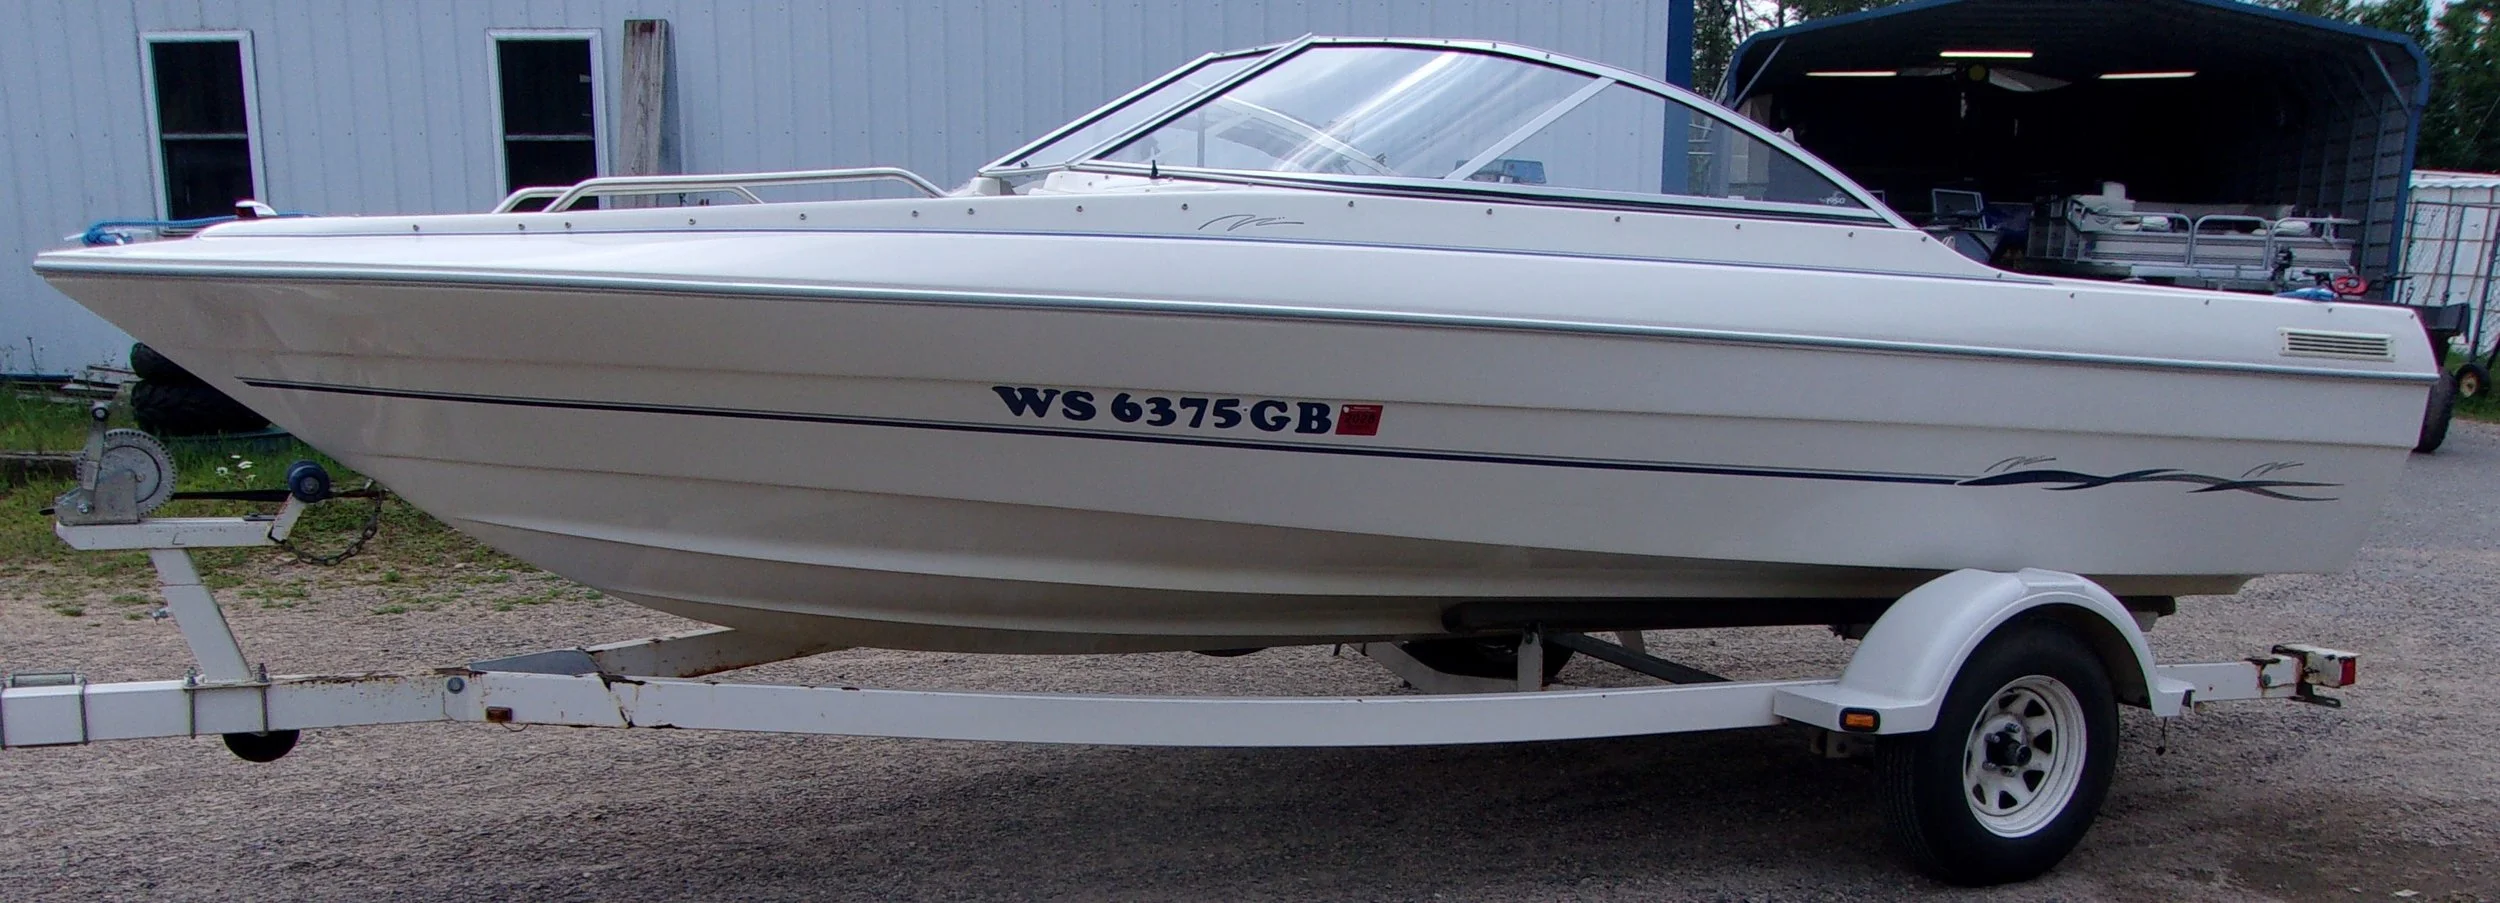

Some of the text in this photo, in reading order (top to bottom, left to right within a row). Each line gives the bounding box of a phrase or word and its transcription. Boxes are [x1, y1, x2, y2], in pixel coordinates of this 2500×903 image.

[991, 385, 1333, 435] WS 6375 GB
